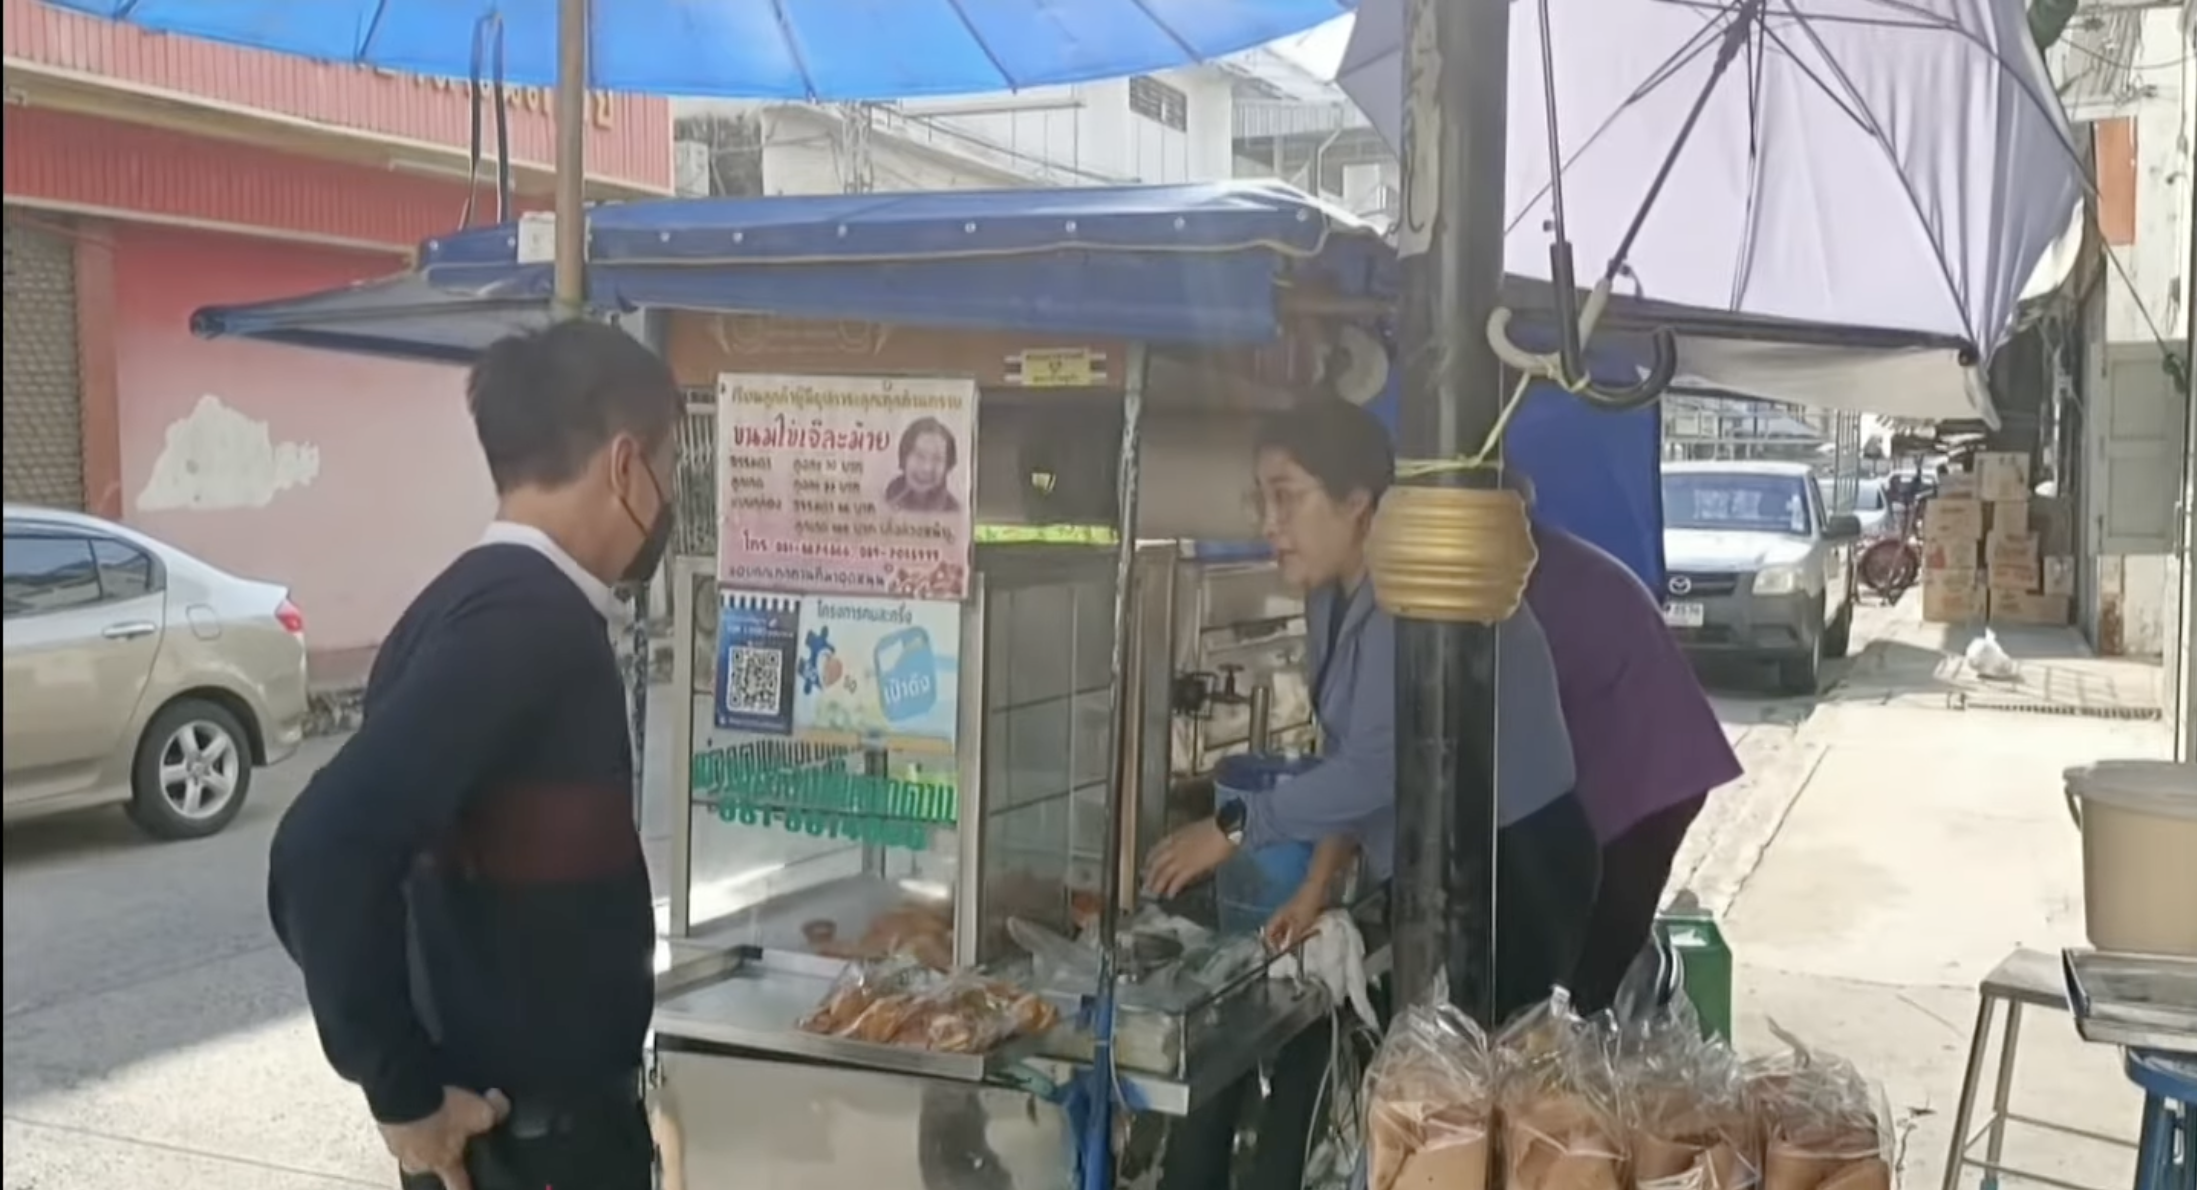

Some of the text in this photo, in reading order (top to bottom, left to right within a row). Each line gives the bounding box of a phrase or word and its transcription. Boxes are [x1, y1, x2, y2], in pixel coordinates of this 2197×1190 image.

[733, 411, 890, 452] ขนมไข่เจ๊ละม้าย
[816, 598, 913, 625] โครงการคนละครึ่ง
